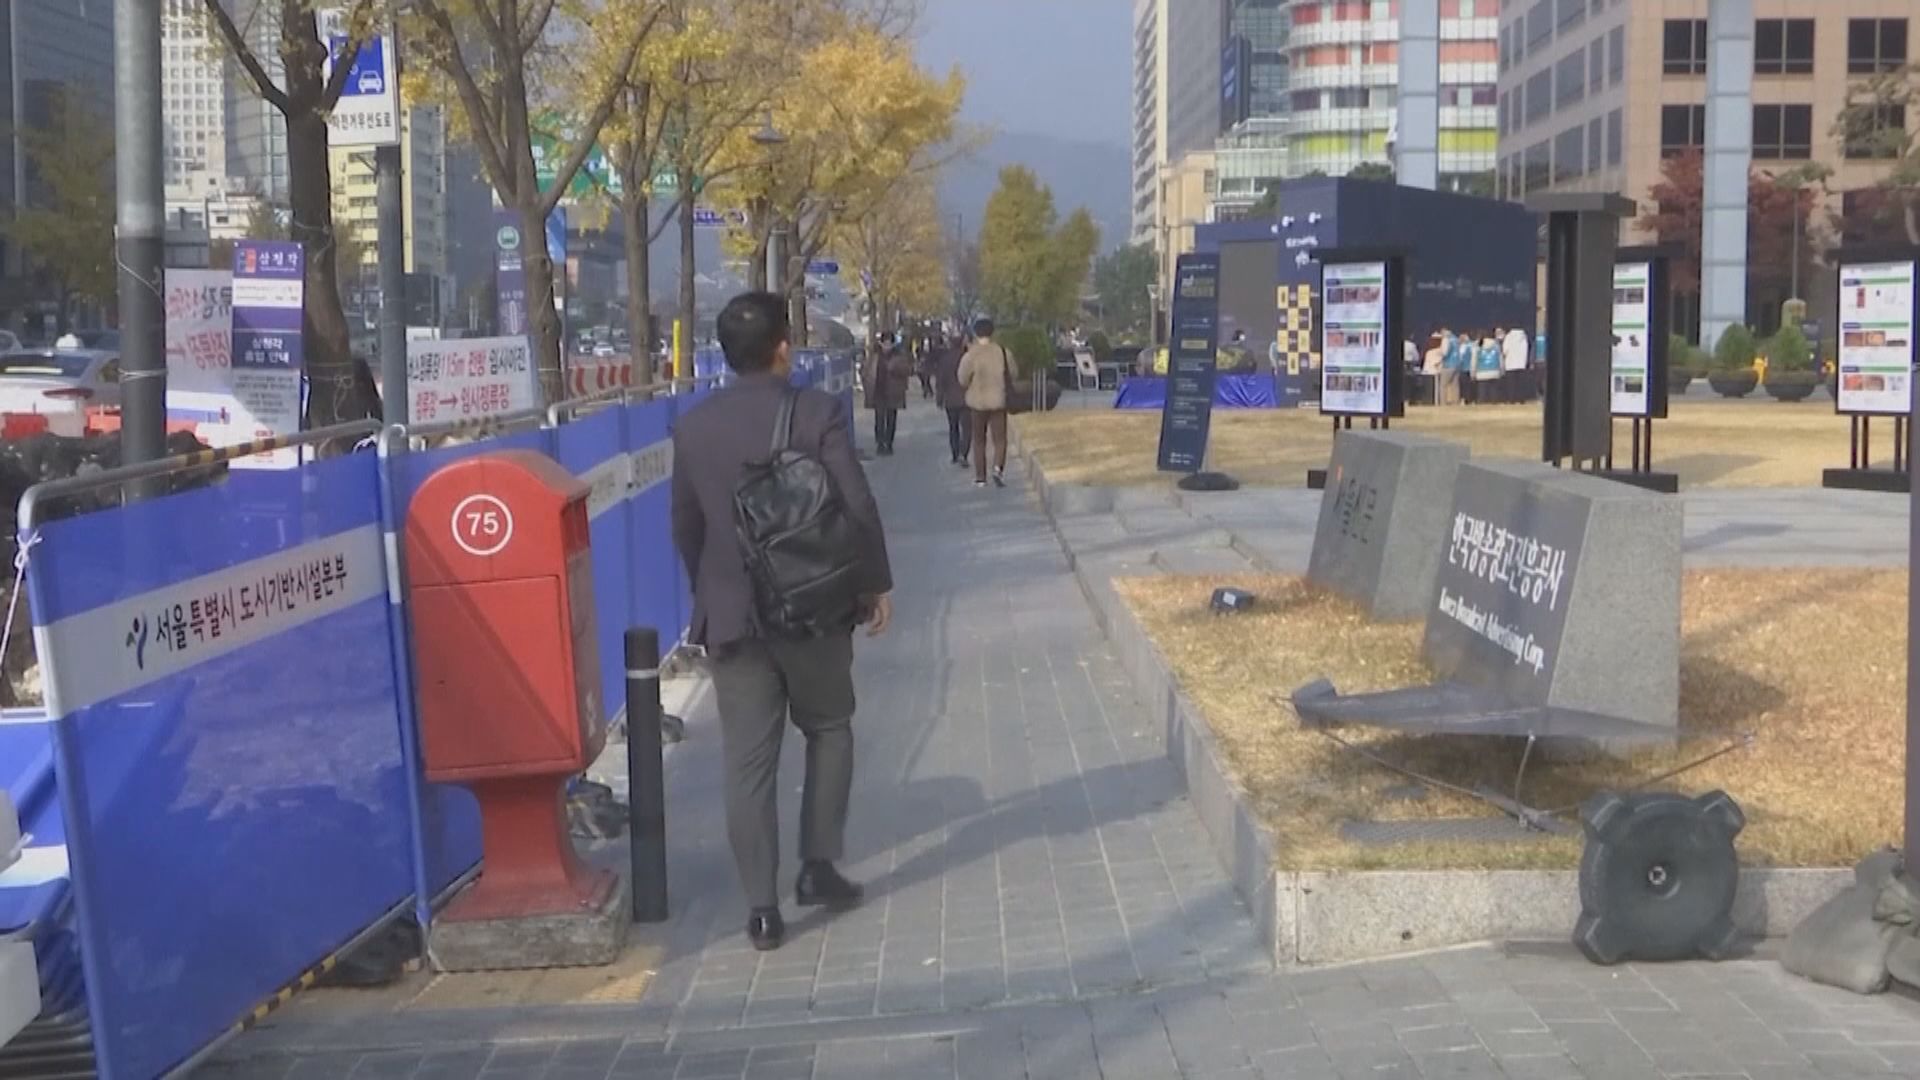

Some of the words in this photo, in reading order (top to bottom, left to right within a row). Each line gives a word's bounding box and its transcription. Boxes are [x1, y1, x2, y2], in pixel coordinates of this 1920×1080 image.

[461, 383, 510, 414] 임시정류장
[466, 511, 500, 536] 75
[1449, 511, 1566, 612] 한국방송광고진흥공사
[155, 587, 237, 651] 서울특별시
[239, 553, 348, 622] 도시기반시설본부
[1486, 611, 1525, 665] Advertising
